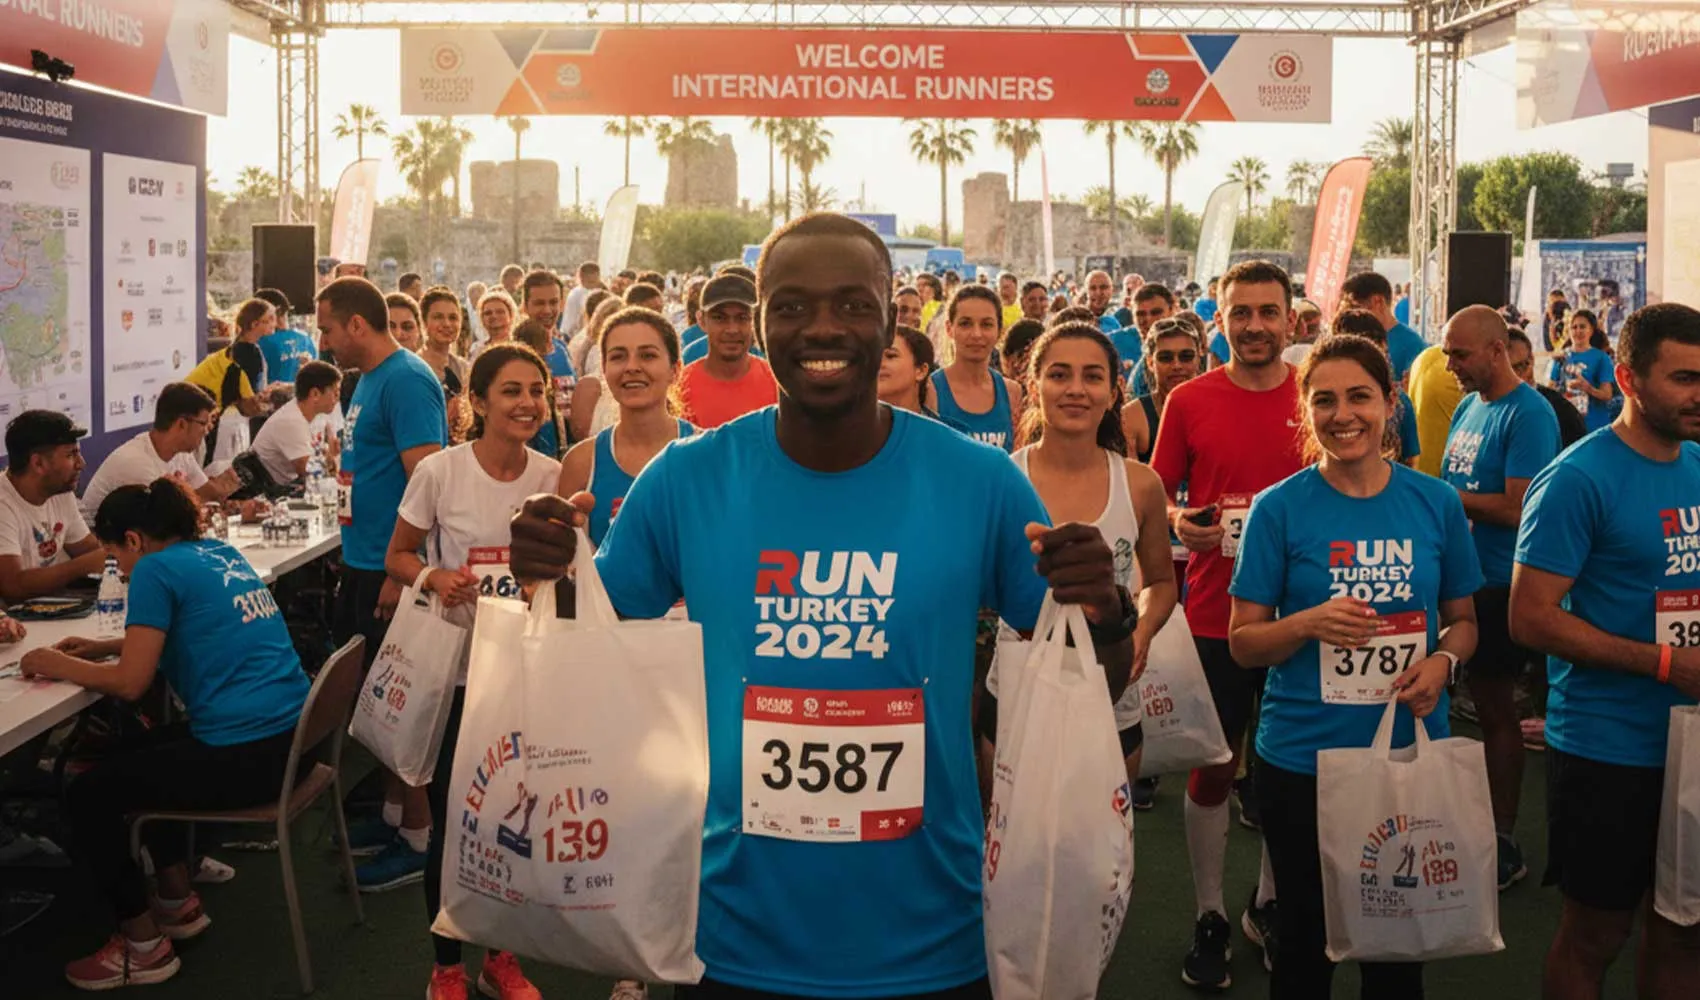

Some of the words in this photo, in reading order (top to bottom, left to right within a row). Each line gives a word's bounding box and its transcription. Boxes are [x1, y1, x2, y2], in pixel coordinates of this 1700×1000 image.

[795, 44, 945, 69] WELCOME
[672, 74, 907, 99] INTERNATIONAL
[915, 76, 1055, 101] RUNNERS
[1659, 506, 1700, 537] RU
[1329, 538, 1413, 567] RUN
[755, 549, 898, 597] RUN
[1329, 582, 1414, 602] 2024
[755, 596, 895, 623] TURKEY
[755, 623, 890, 659] 2024
[1333, 643, 1417, 677] 3787
[761, 739, 905, 794] 3587
